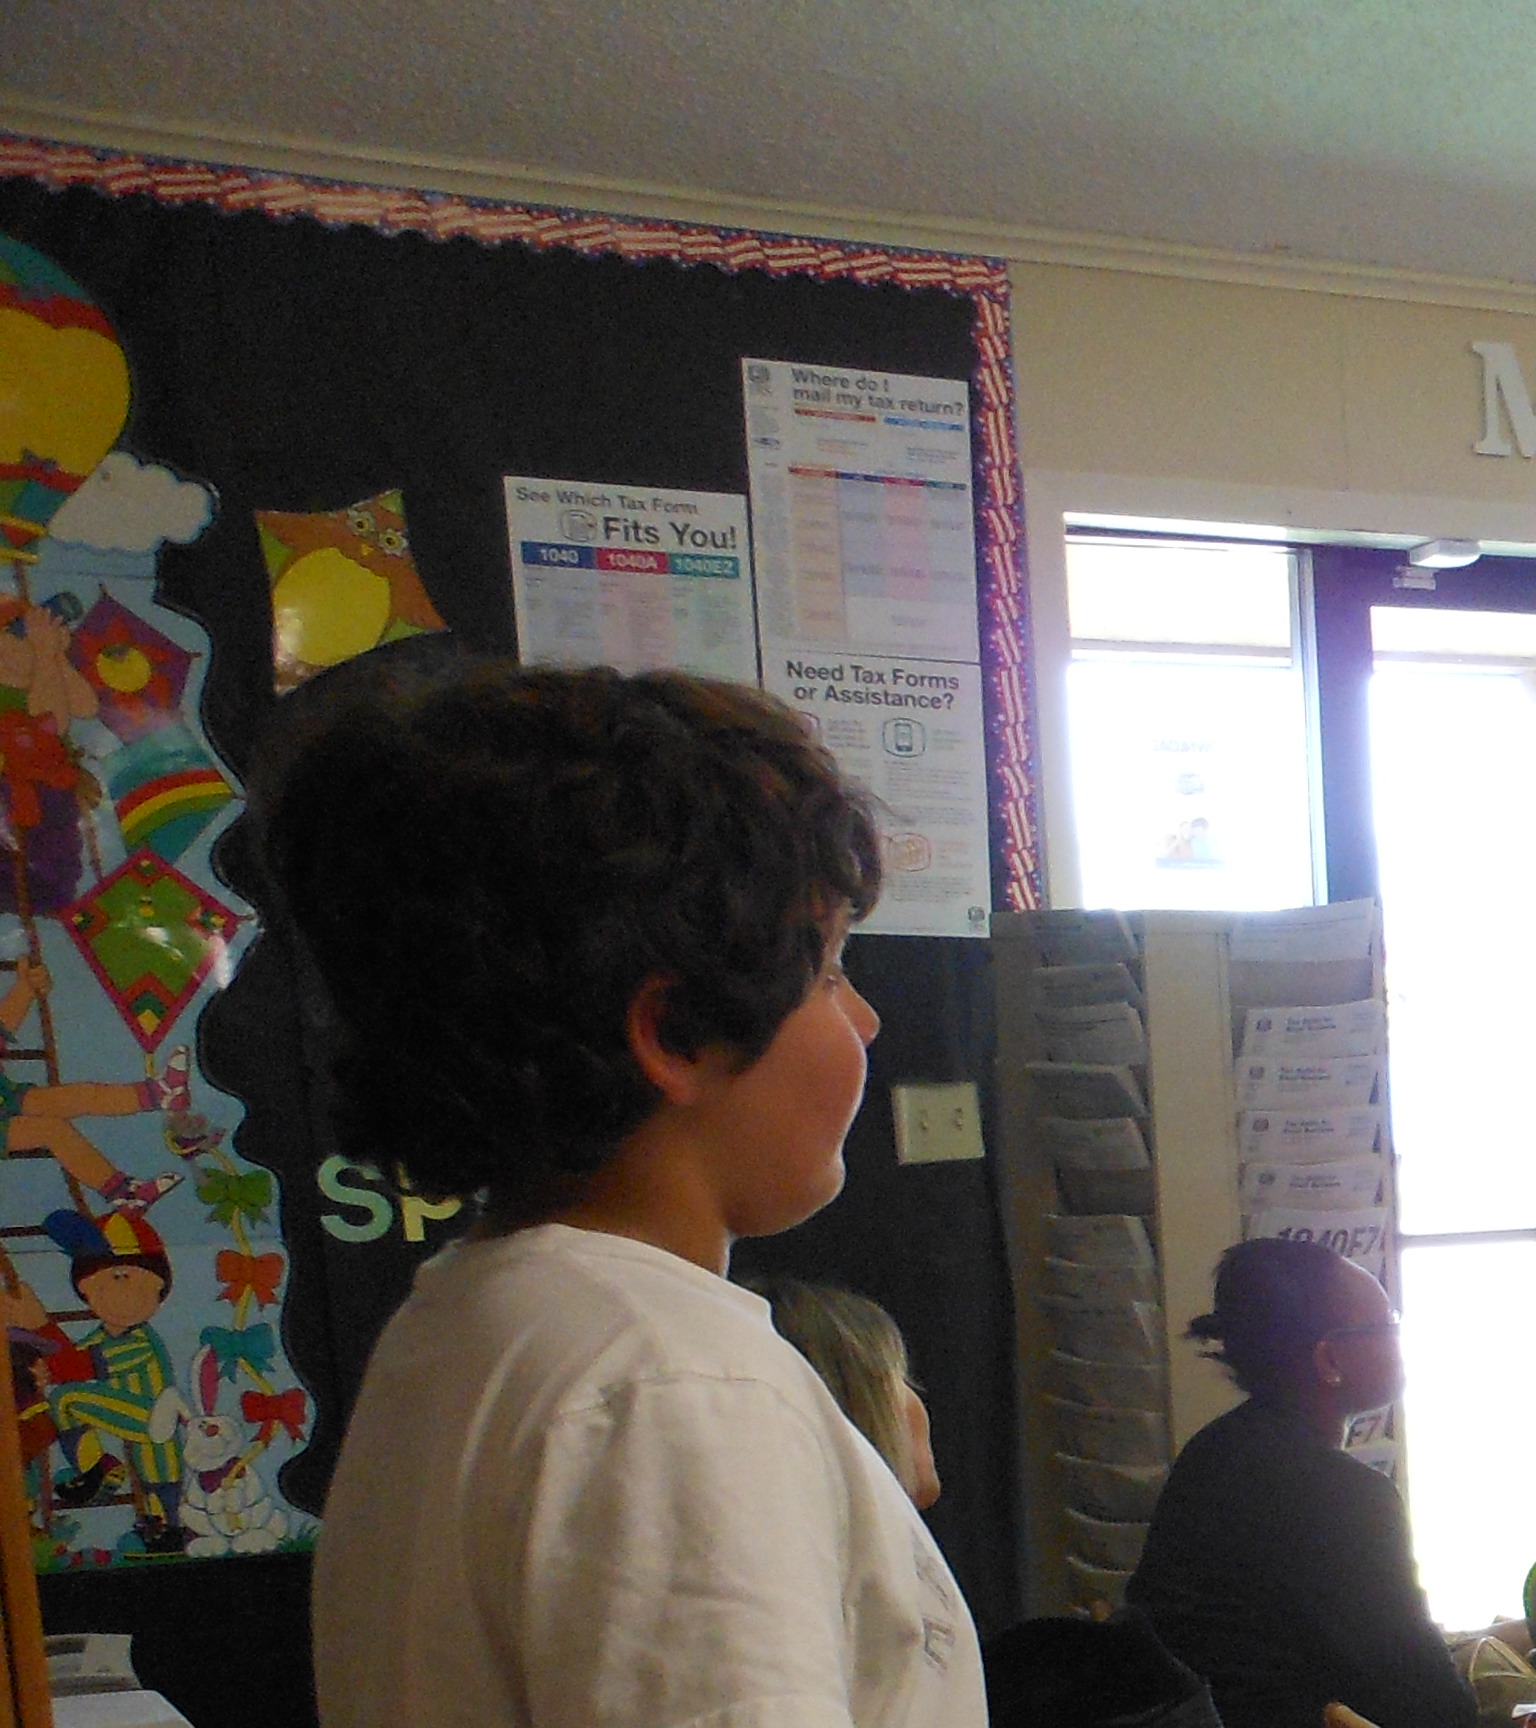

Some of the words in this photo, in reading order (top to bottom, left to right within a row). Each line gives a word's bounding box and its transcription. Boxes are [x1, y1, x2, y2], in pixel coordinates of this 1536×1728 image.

[791, 368, 849, 388] Where
[856, 376, 877, 392] do
[793, 386, 830, 402] mail
[836, 391, 861, 409] my
[867, 393, 893, 411] tax
[900, 399, 964, 416] return?
[516, 487, 550, 502] See
[557, 489, 611, 507] Which
[619, 494, 646, 510] Tax
[653, 498, 699, 515] Form
[602, 516, 660, 544] Fits
[669, 521, 738, 550] You!
[540, 548, 579, 564] 1040
[608, 552, 658, 571] 1040A
[786, 660, 844, 682] Need
[851, 665, 886, 685] Tax
[892, 669, 960, 690] Forms
[794, 685, 817, 701] or
[824, 685, 955, 711] Assistance?
